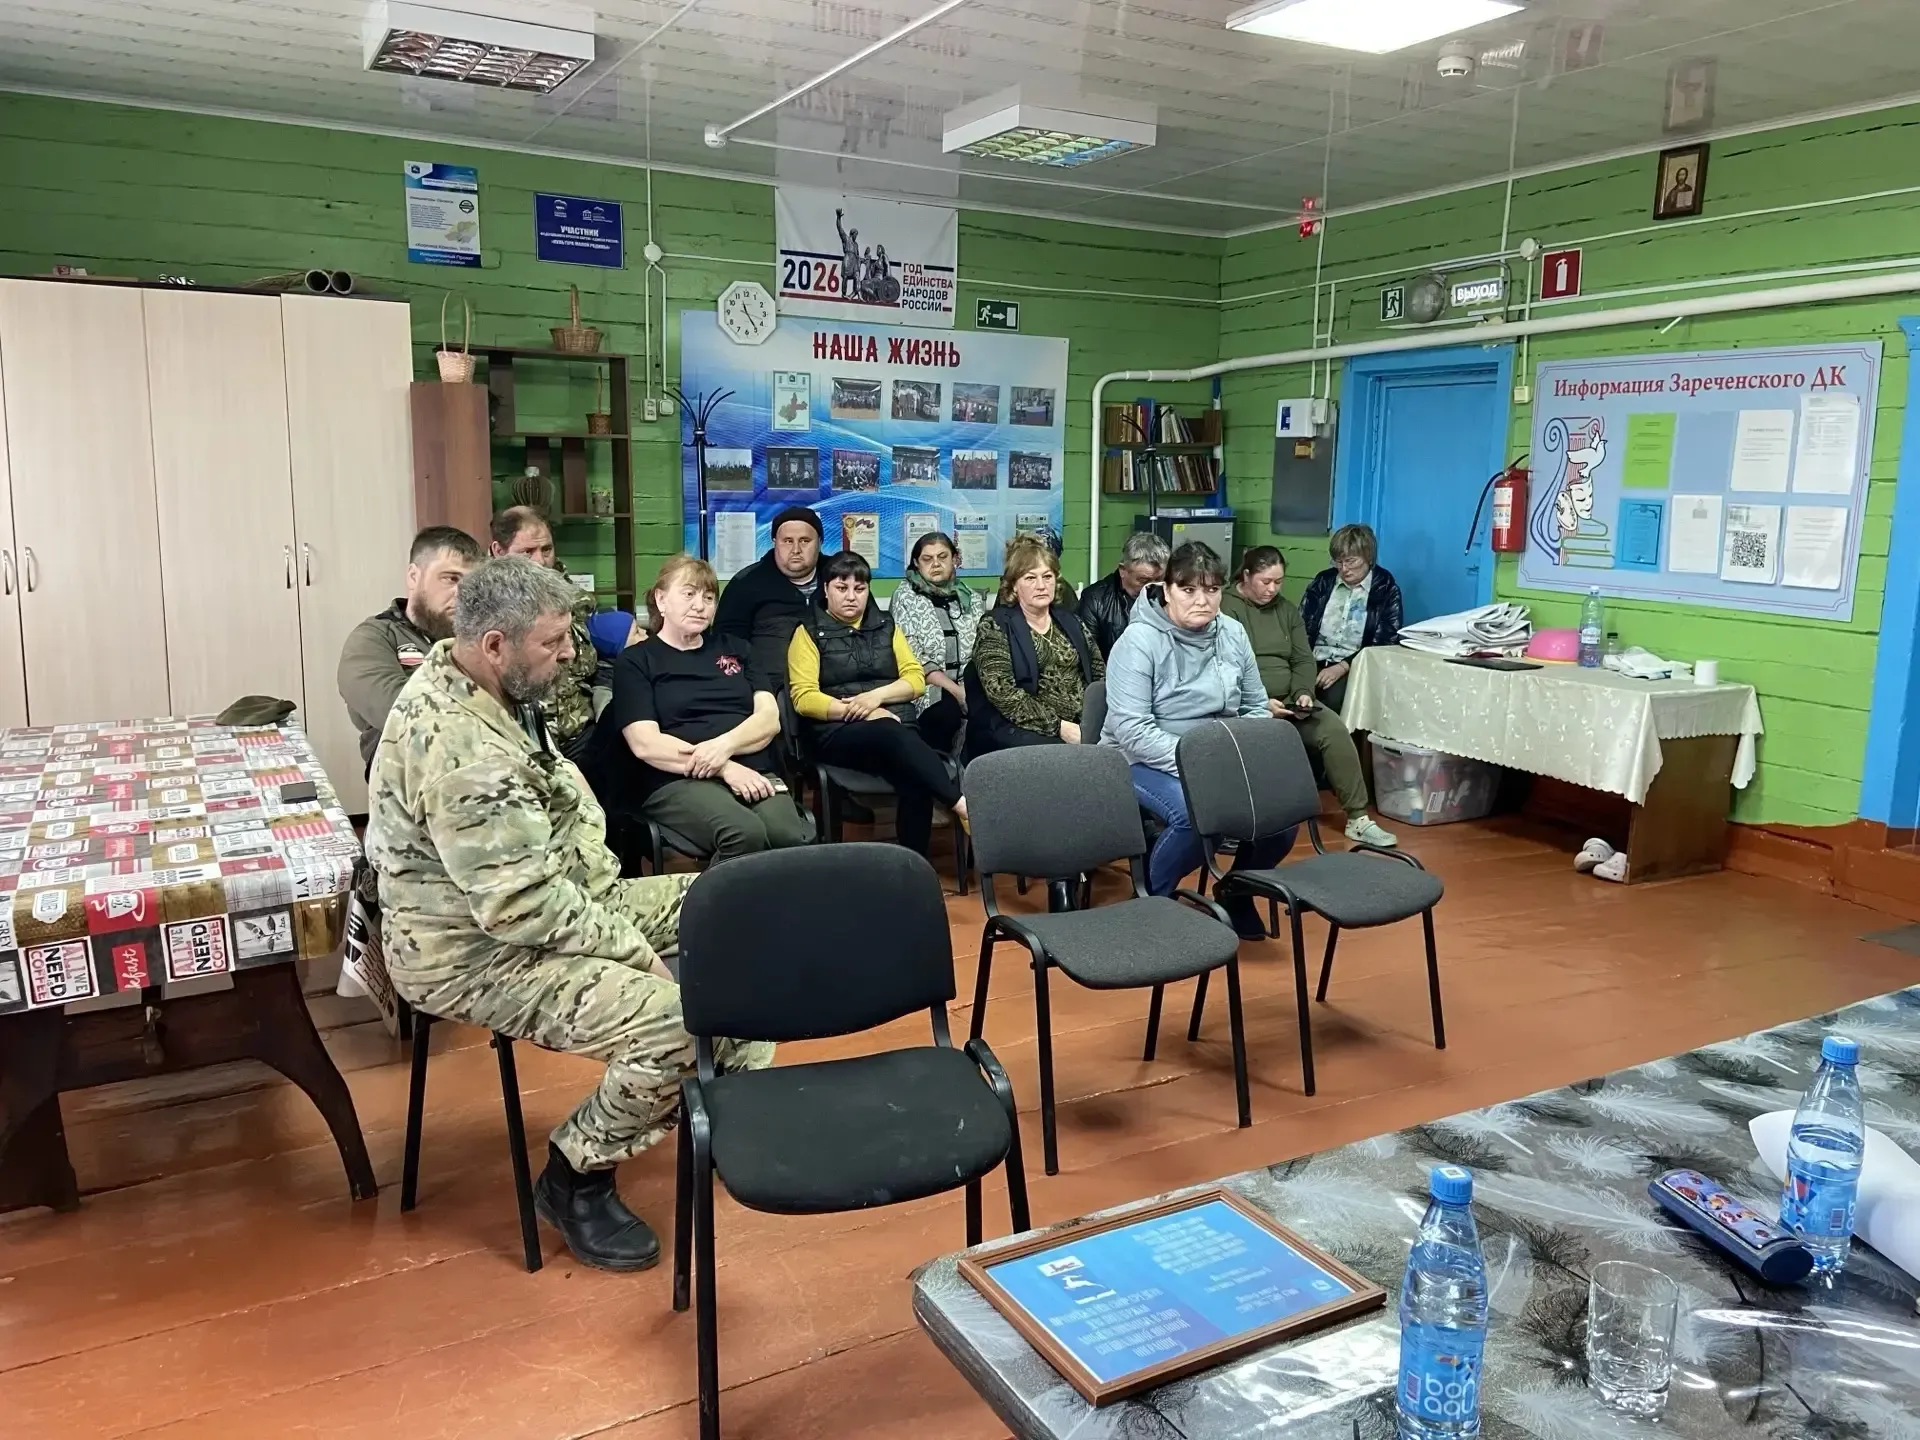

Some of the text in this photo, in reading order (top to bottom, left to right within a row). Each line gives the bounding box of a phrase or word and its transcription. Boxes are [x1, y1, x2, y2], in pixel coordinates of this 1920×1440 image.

[560, 225, 599, 237] УЧАСТНИК
[783, 258, 840, 293] 2026
[903, 262, 923, 275] ГОД
[903, 275, 954, 290] ЕДИНСТВА
[901, 299, 942, 312] РОССИИ
[902, 288, 948, 301] НАРОДОВ
[1457, 283, 1498, 301] ВЫХОД
[812, 332, 961, 368] НАША ЖИЗНЬ
[1553, 365, 1847, 401] Информация Зареченского ДК
[172, 940, 195, 972] ALL
[209, 921, 224, 969] COFFEE
[31, 950, 48, 1000] COFFEE
[61, 945, 86, 979] ALL
